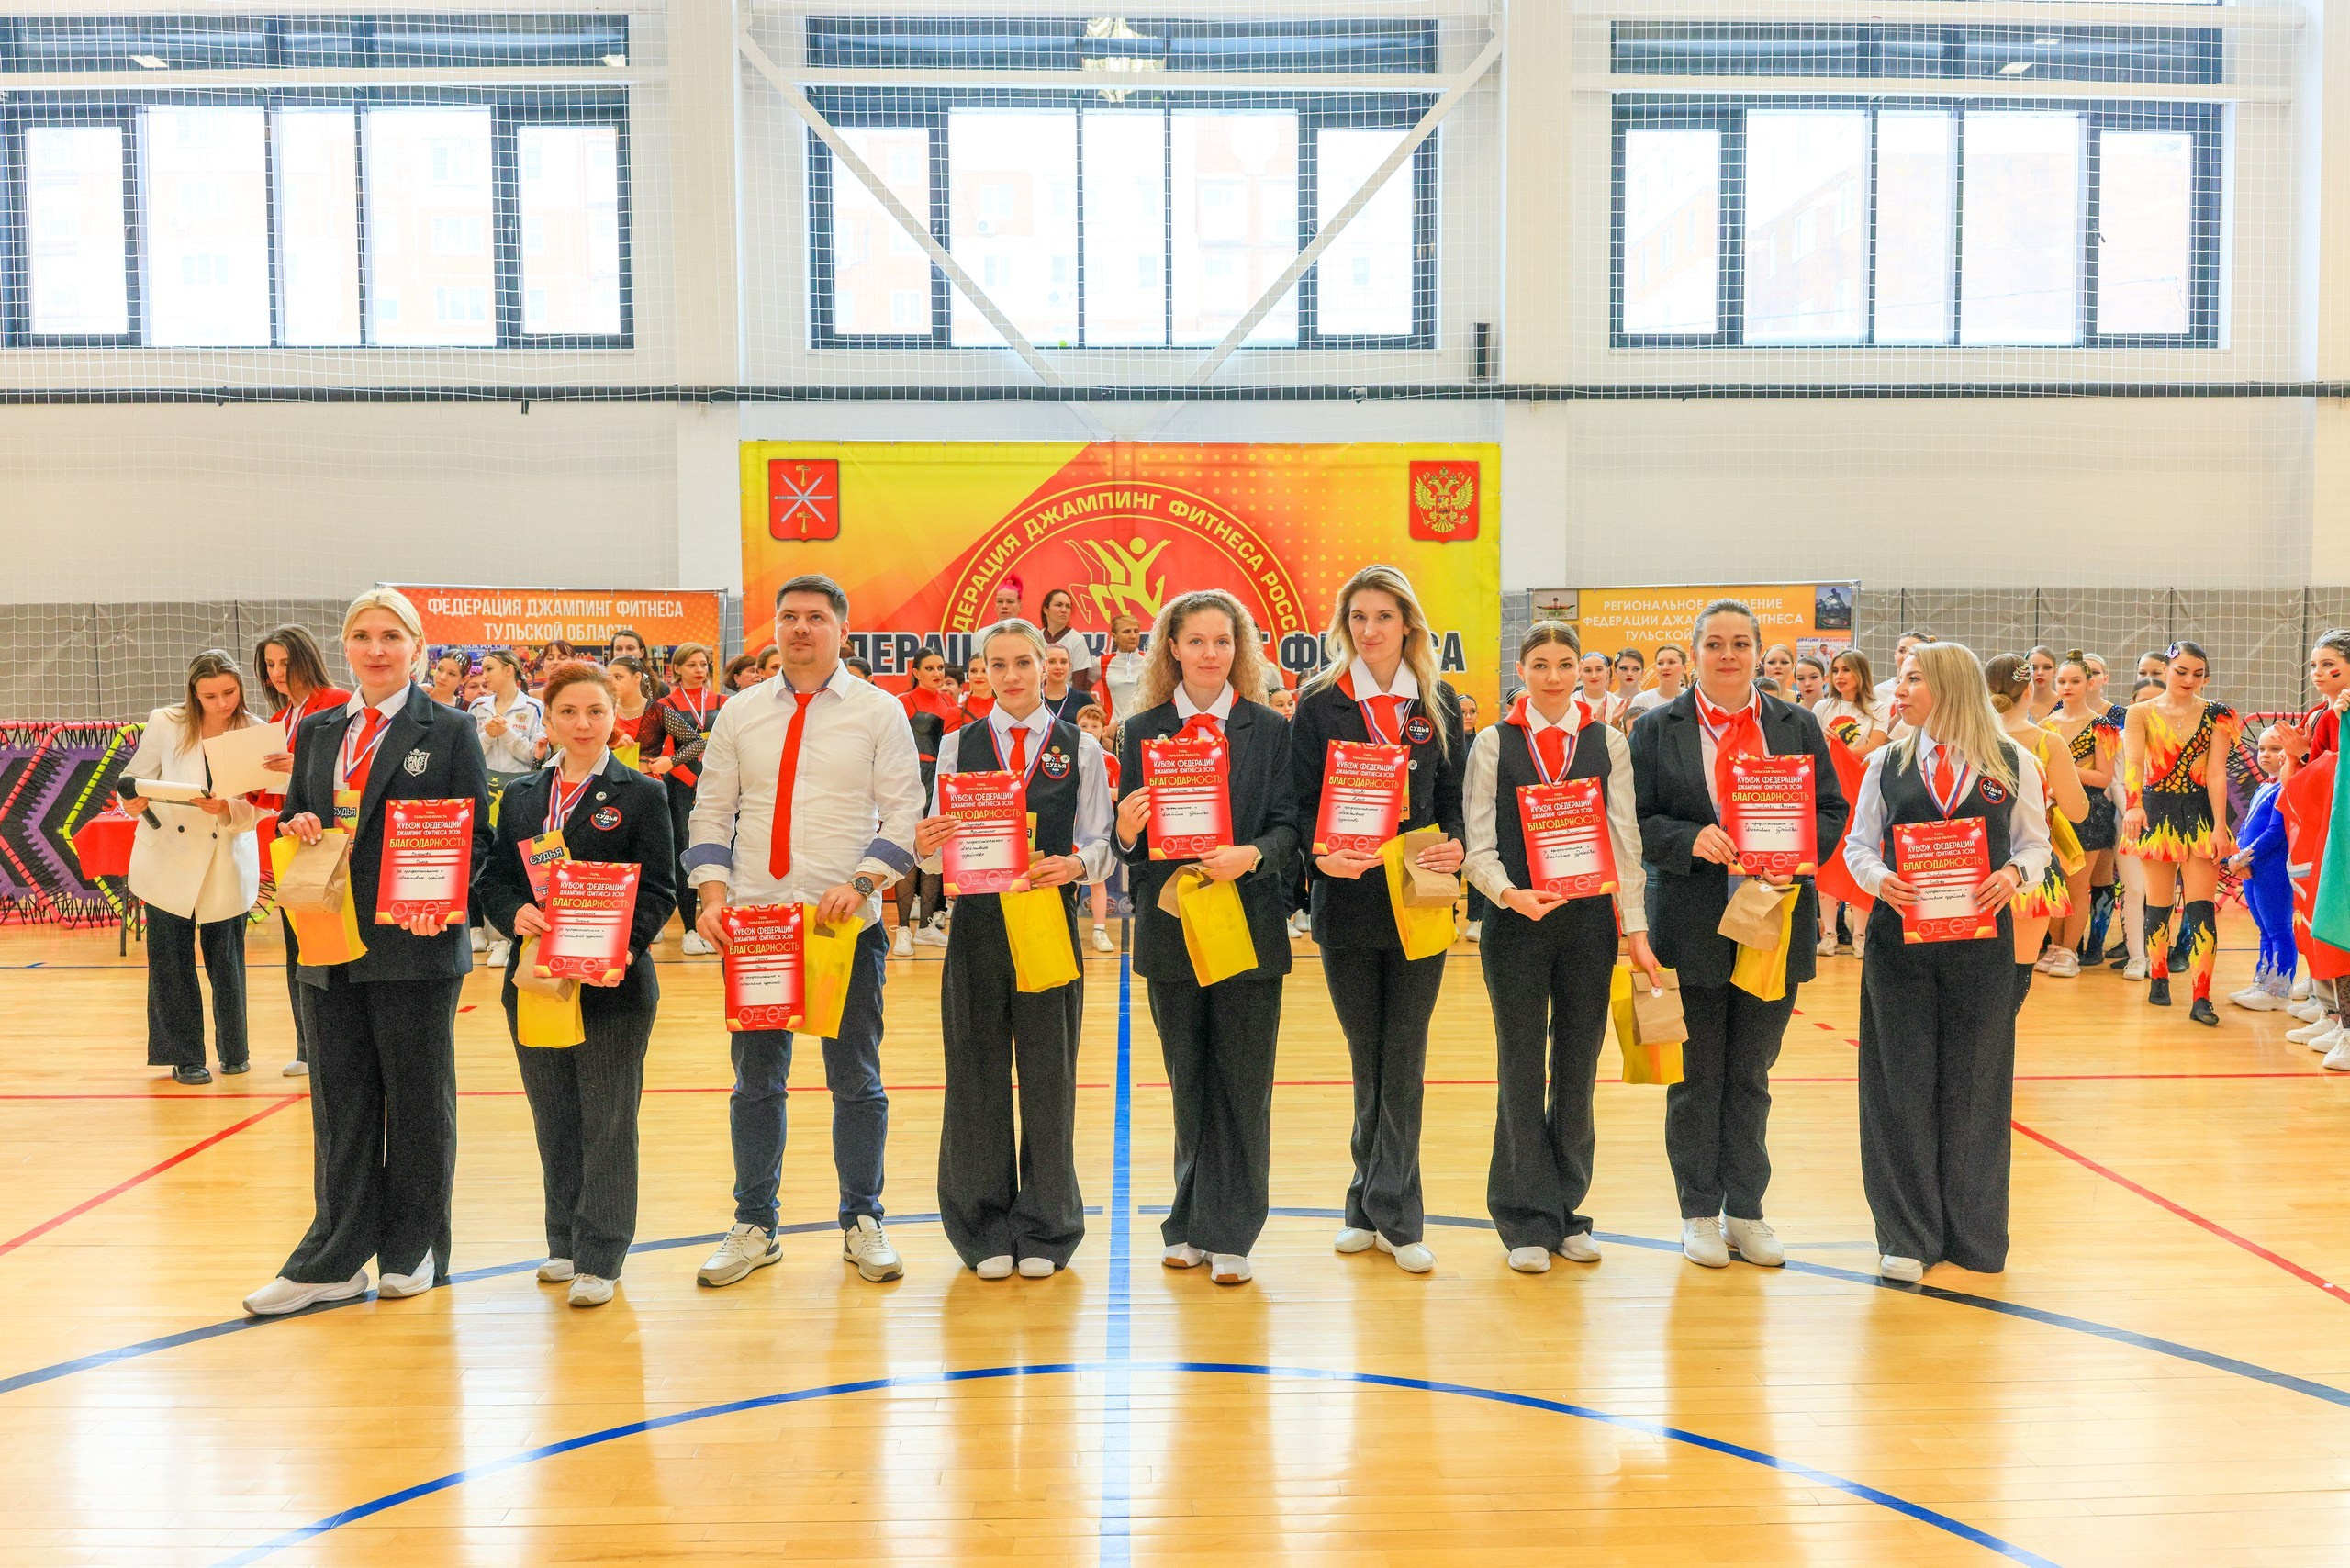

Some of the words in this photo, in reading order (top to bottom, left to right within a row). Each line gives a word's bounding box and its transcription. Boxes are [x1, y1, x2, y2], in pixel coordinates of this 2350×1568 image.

[952, 533, 1022, 633] ДЕРАЦИЯ
[1024, 492, 1161, 541] ДЖАМПИНГ
[1169, 500, 1264, 572] ФИТНЕСА
[1260, 571, 1299, 635] РОСС
[428, 598, 522, 618] ФЕДЕРАЦИЯ
[526, 599, 612, 618] ДЖАМПИНГ
[616, 599, 683, 618] ФИТНЕСА
[1604, 599, 1704, 610] РЕГИОНАЛЬНОЕ
[1583, 615, 1658, 627] ФЕДЕРАЦИИ
[1757, 613, 1804, 624] ИТНЕСА
[484, 622, 563, 641] ТУЛЬСКОЙ
[1625, 628, 1694, 641] ТУЛЬСКОЙ
[1177, 759, 1214, 767] ФЕДЕРАЦИИ
[1360, 763, 1395, 771] ФЕДЕРАЦИИ
[1149, 775, 1222, 786] БЛАГОДАРНОСТЬ
[1329, 777, 1399, 789] БЛАГОДАРНОСТЬ
[1983, 784, 2003, 795] СУДЬЯ
[975, 792, 1013, 801] ФЕДЕРАЦИИ
[1732, 792, 1808, 801] БЛАГОДАРНОСТЬ
[1530, 804, 1552, 812] КУБОК
[1554, 800, 1592, 810] ФЕДЕРАЦИИ
[595, 813, 618, 822] СУДЬЯ
[1528, 815, 1601, 831] БЛАГОДАРНОСТЬ
[422, 821, 461, 829] ФЕДЕРАЦИИ
[389, 837, 466, 848] БЛАГОДАРНОСТЬ
[1933, 840, 1975, 850] ФЕДЕРАЦИИ
[530, 847, 563, 865] СУДЬЯ
[1903, 857, 1983, 870] БЛАГОДАРНОСТЬ
[560, 881, 584, 890] КУБОК
[587, 882, 626, 890] ФЕДЕРАЦИИ
[553, 898, 630, 908] БЛАГОДАРНОСТЬ
[734, 927, 755, 935] КУБОК
[757, 925, 793, 935] ФЕДЕРАЦИИ
[730, 943, 799, 955] БЛАГОДАРНОСТЬ
